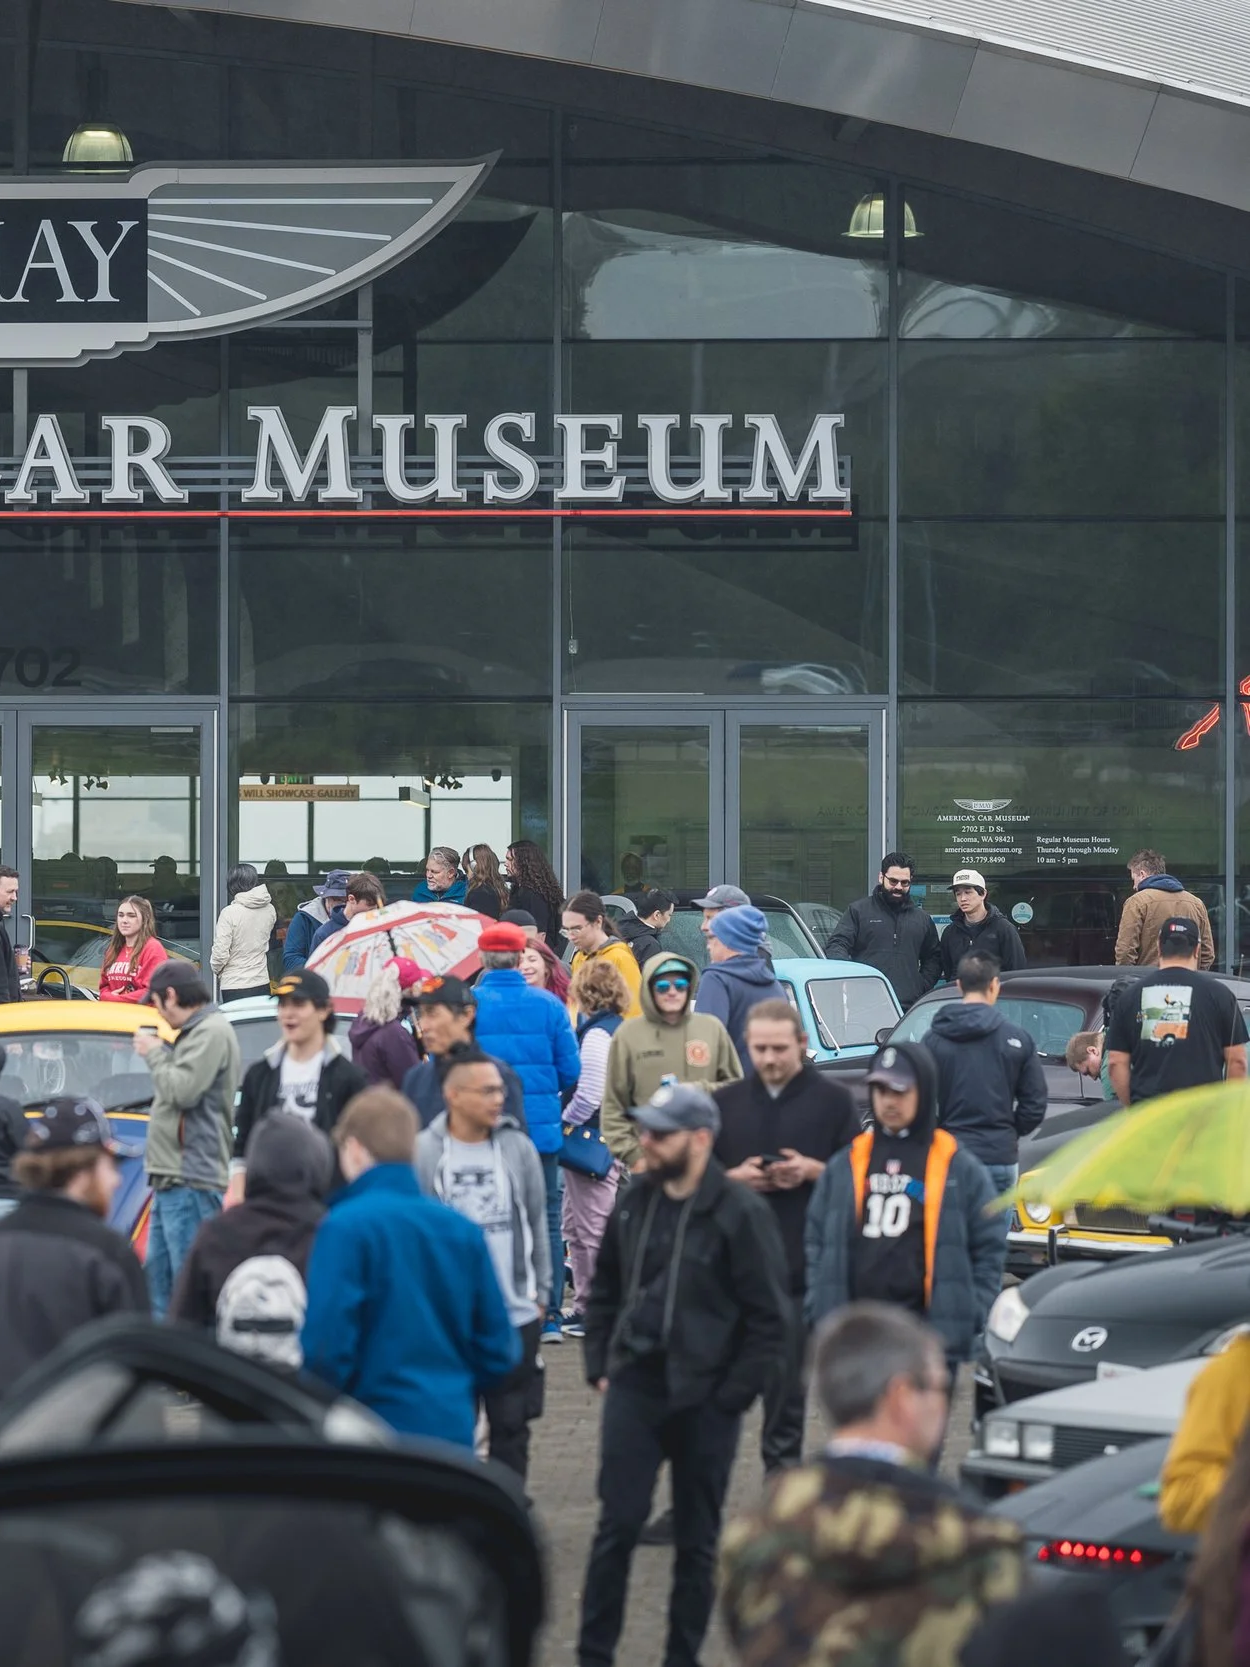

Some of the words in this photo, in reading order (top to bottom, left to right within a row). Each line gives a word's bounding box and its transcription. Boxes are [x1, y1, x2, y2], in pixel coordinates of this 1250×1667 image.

[241, 404, 850, 505] MUSEUM
[244, 789, 264, 798] WILL
[267, 789, 315, 798] SHOWCASE
[317, 789, 356, 798] GALLERY
[952, 836, 980, 844] Tacoma,
[1036, 836, 1062, 844] Regular
[944, 846, 1023, 854] americascarmuseum.org
[1036, 846, 1066, 854] Thursday
[1067, 846, 1092, 854] through
[1092, 846, 1120, 854] Monday
[961, 856, 1006, 864] 253.779.8490
[862, 1193, 912, 1238] 10
